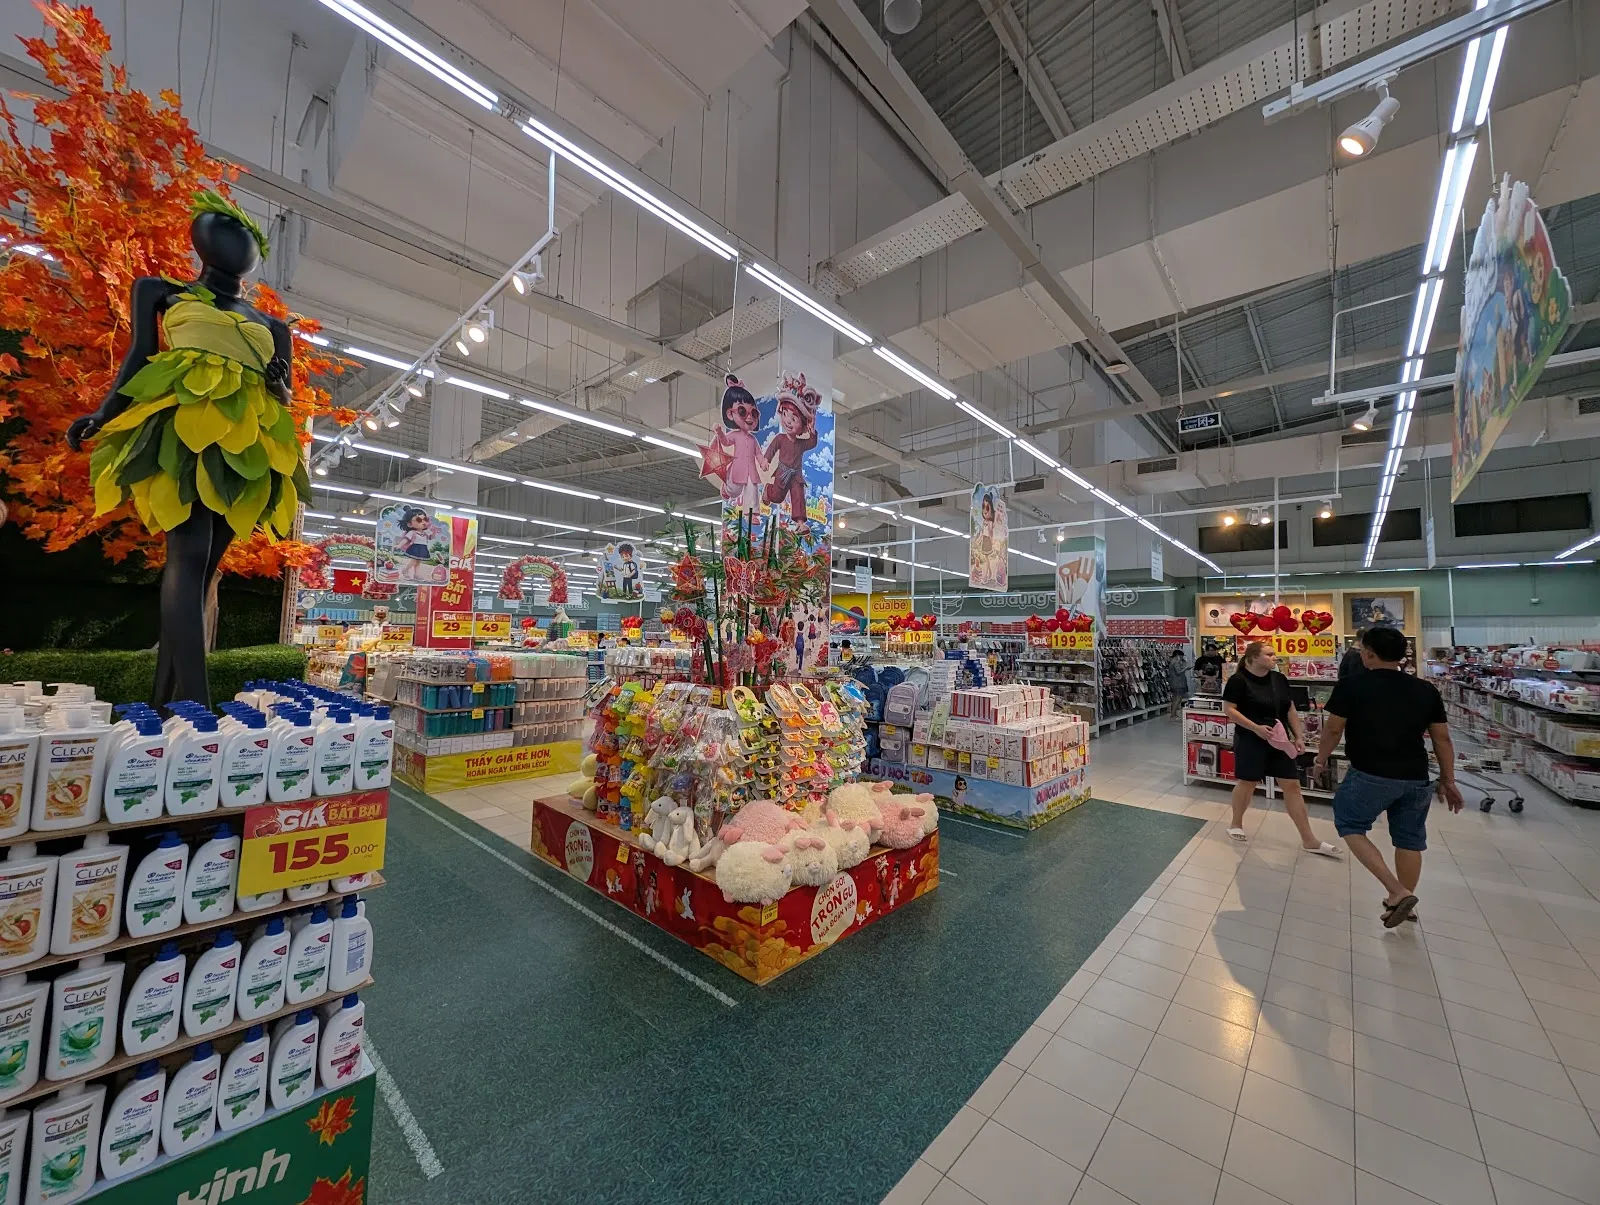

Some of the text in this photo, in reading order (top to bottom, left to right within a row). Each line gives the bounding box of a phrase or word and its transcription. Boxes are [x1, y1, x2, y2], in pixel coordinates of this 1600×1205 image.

[442, 622, 460, 632] 29
[482, 624, 500, 632] 49
[910, 633, 920, 642] 10
[1054, 635, 1076, 648] 199
[1276, 638, 1332, 654] 169 .000
[0, 752, 25, 764] EAR
[51, 746, 94, 757] CLEAR
[465, 752, 492, 768] THẤY
[496, 752, 514, 764] GIÁ
[488, 766, 508, 775] NGAY
[276, 802, 382, 832] GIÁ BẤT BẠI
[268, 832, 350, 874] 155
[76, 865, 118, 880] CLEAR
[0, 877, 43, 894] CLEAR
[812, 884, 854, 930] TRỌN GU
[64, 986, 107, 1004] CLEAR
[45, 1112, 89, 1136] CLEAR
